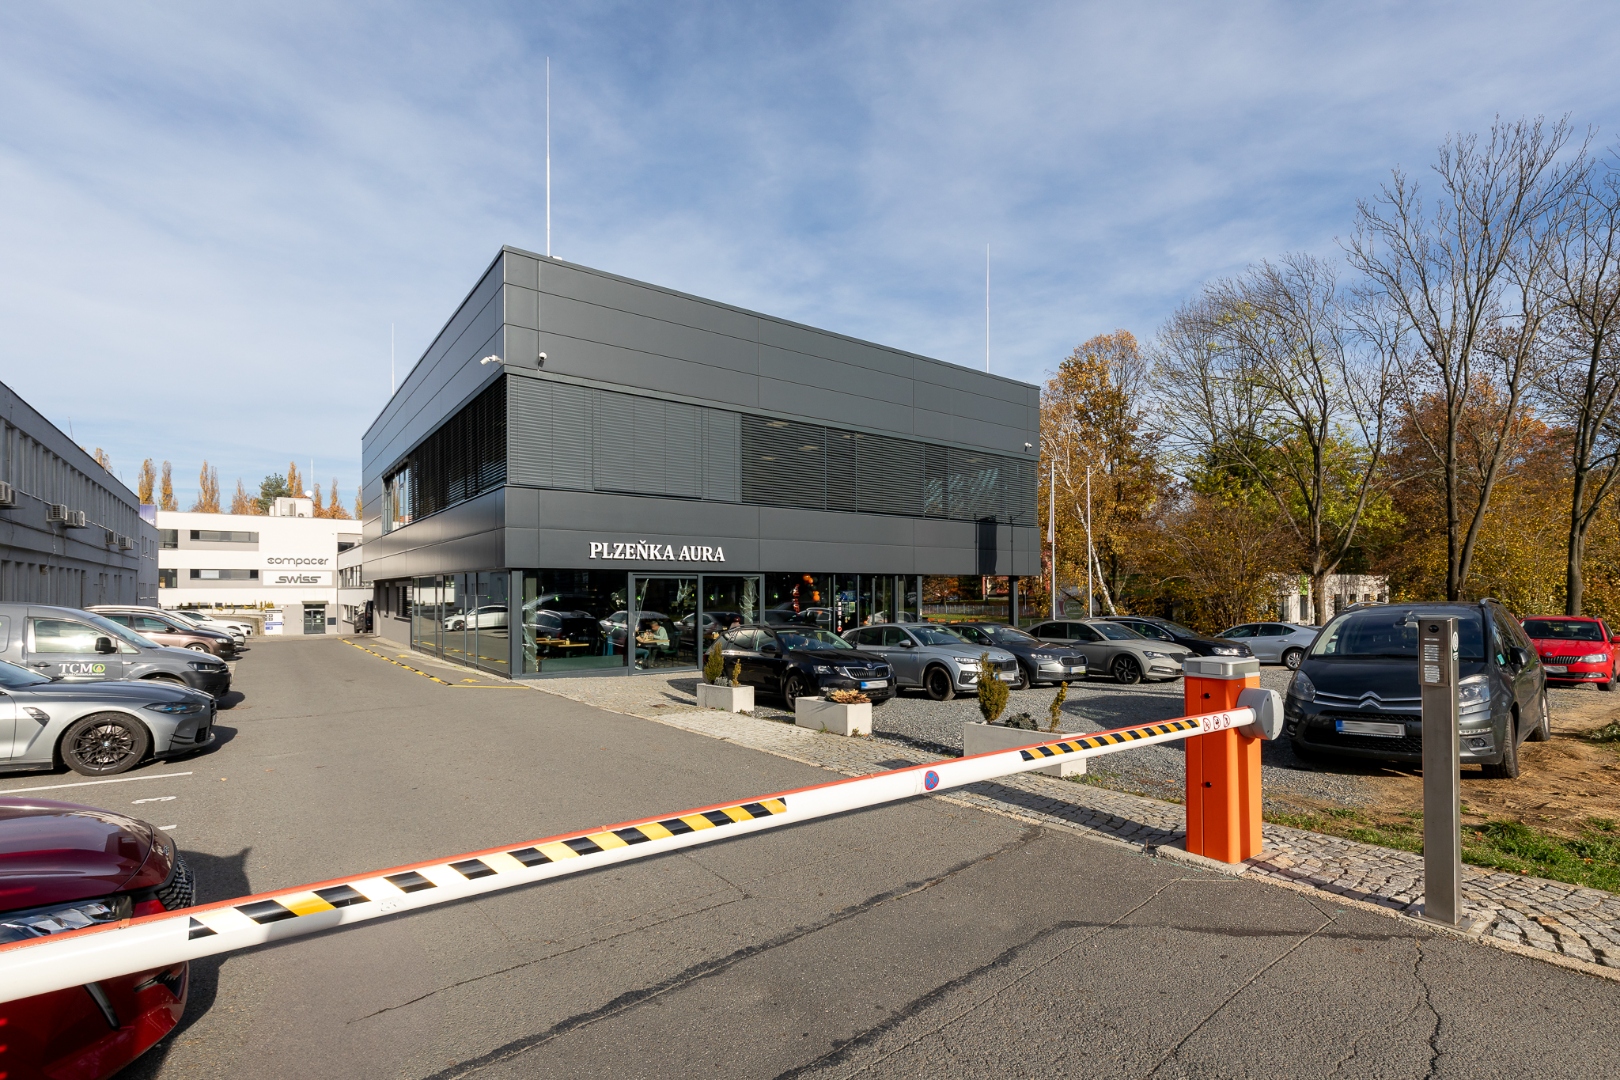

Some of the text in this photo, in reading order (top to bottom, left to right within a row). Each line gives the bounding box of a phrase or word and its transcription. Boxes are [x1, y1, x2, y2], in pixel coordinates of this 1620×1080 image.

[589, 540, 726, 562] PLZEŇKA AURA
[267, 557, 329, 567] compacer
[275, 573, 321, 583] swiss
